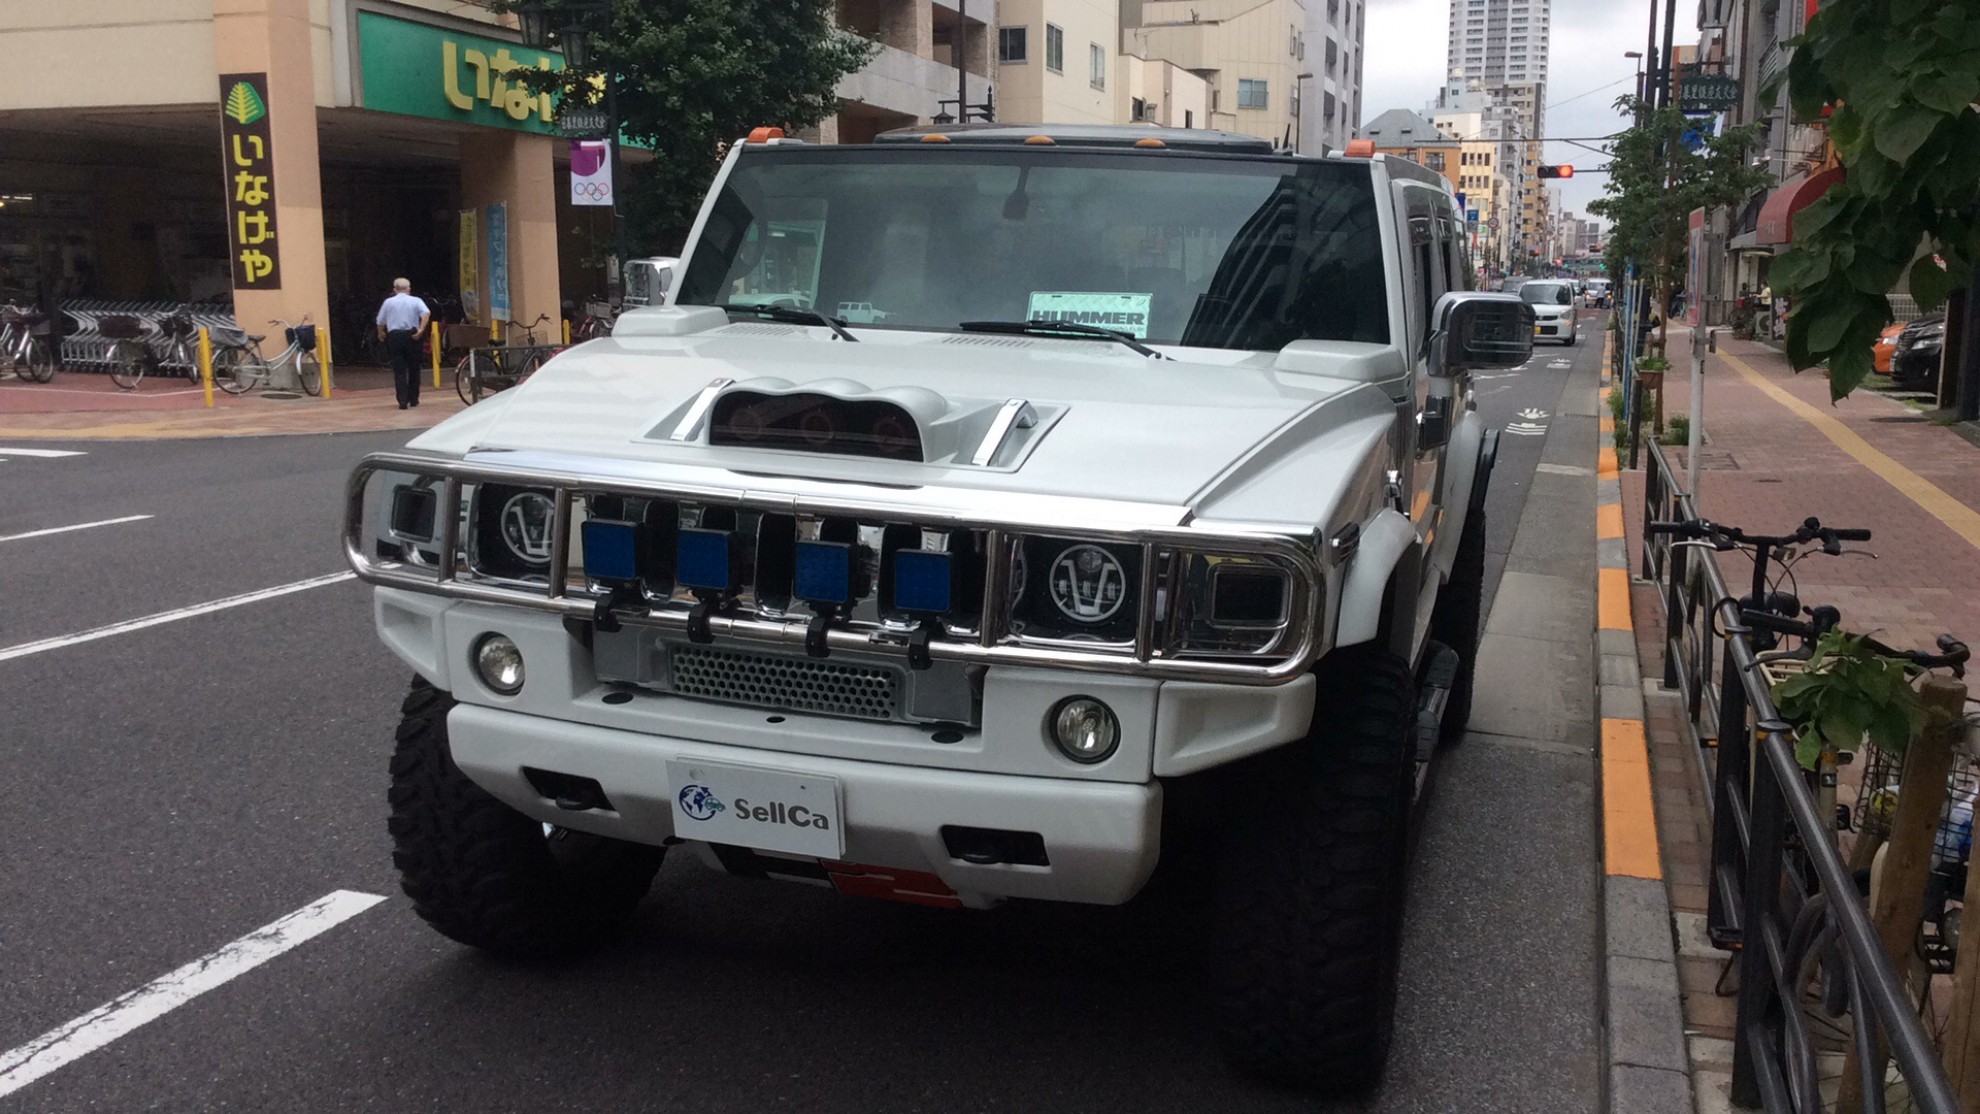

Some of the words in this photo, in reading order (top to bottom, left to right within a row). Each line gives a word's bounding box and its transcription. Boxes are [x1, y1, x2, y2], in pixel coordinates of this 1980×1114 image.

[233, 134, 274, 284] いなげや
[1032, 310, 1145, 325] HUMMER
[734, 798, 829, 830] SellCa
